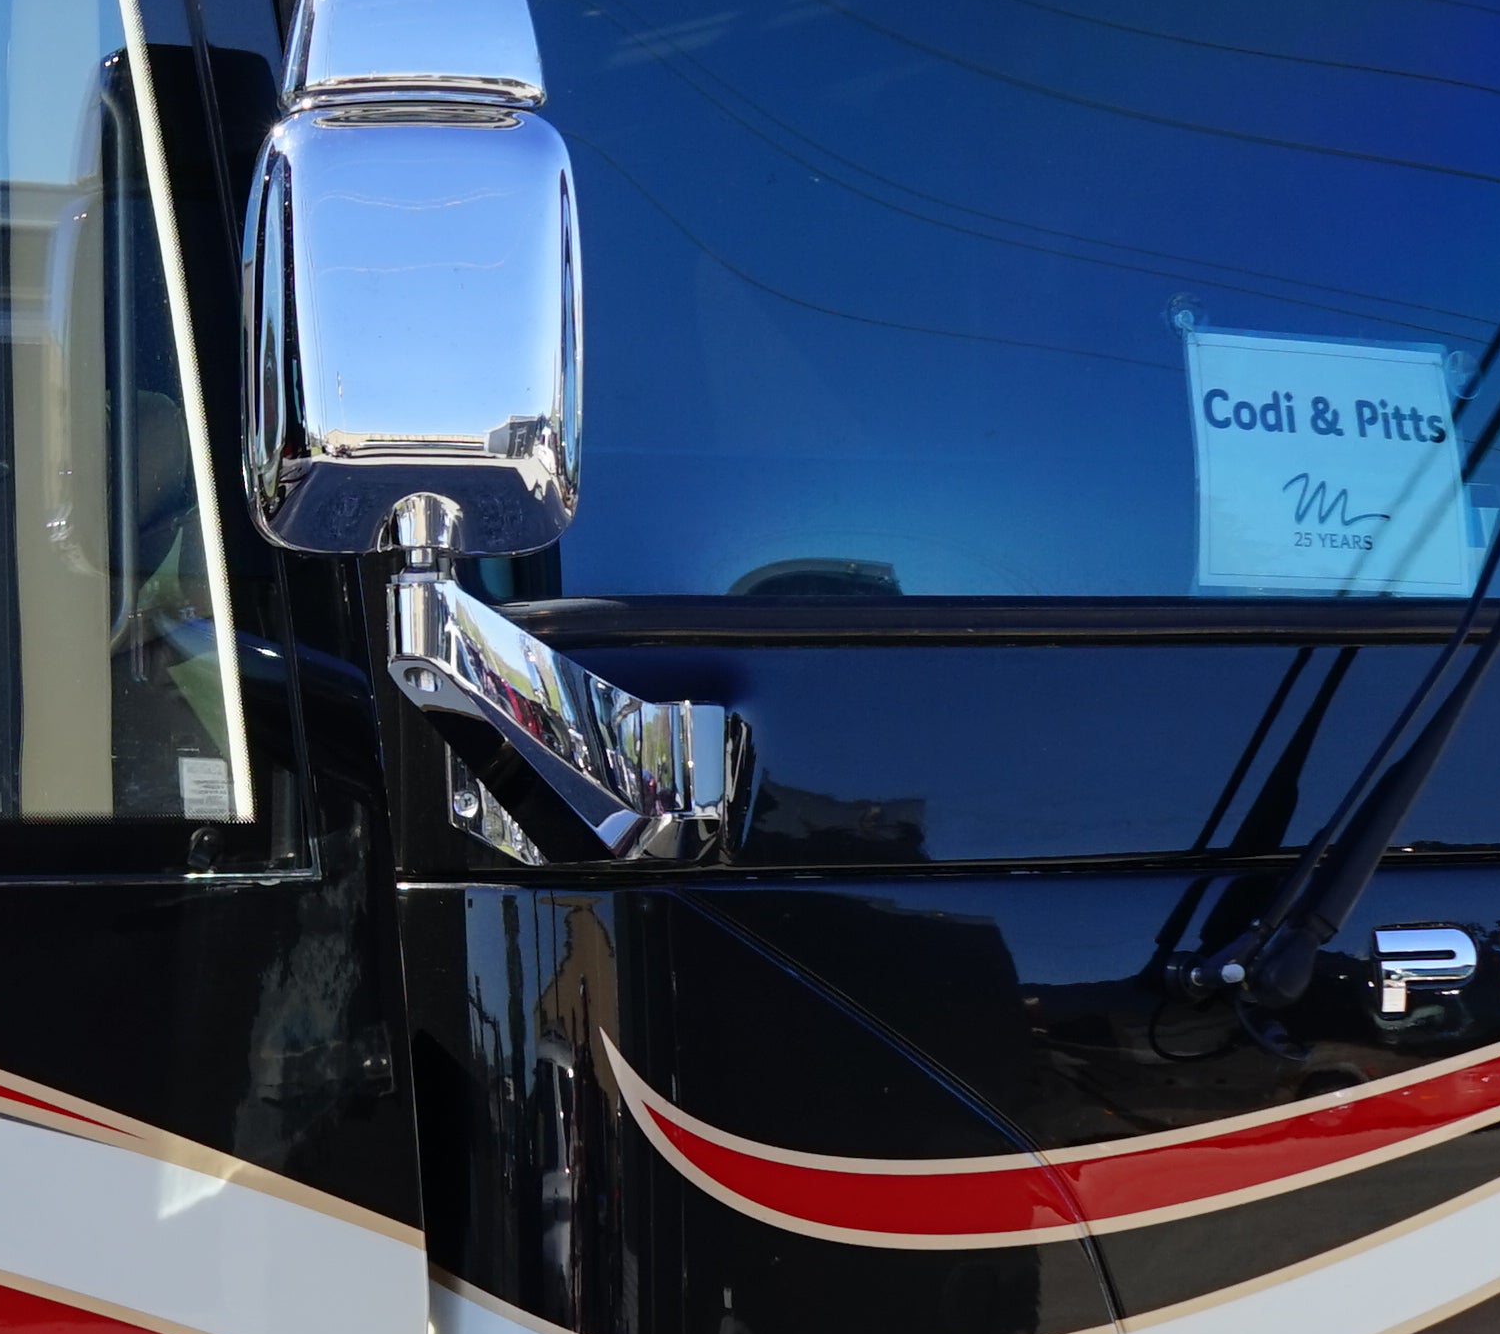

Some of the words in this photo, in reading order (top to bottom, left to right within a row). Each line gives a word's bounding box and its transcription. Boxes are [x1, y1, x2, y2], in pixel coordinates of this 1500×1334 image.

[1203, 387, 1297, 434] Codi
[1310, 396, 1344, 437] &
[1356, 398, 1446, 443] Pitts
[1294, 531, 1312, 548] 25
[1319, 532, 1373, 550] YEARS
